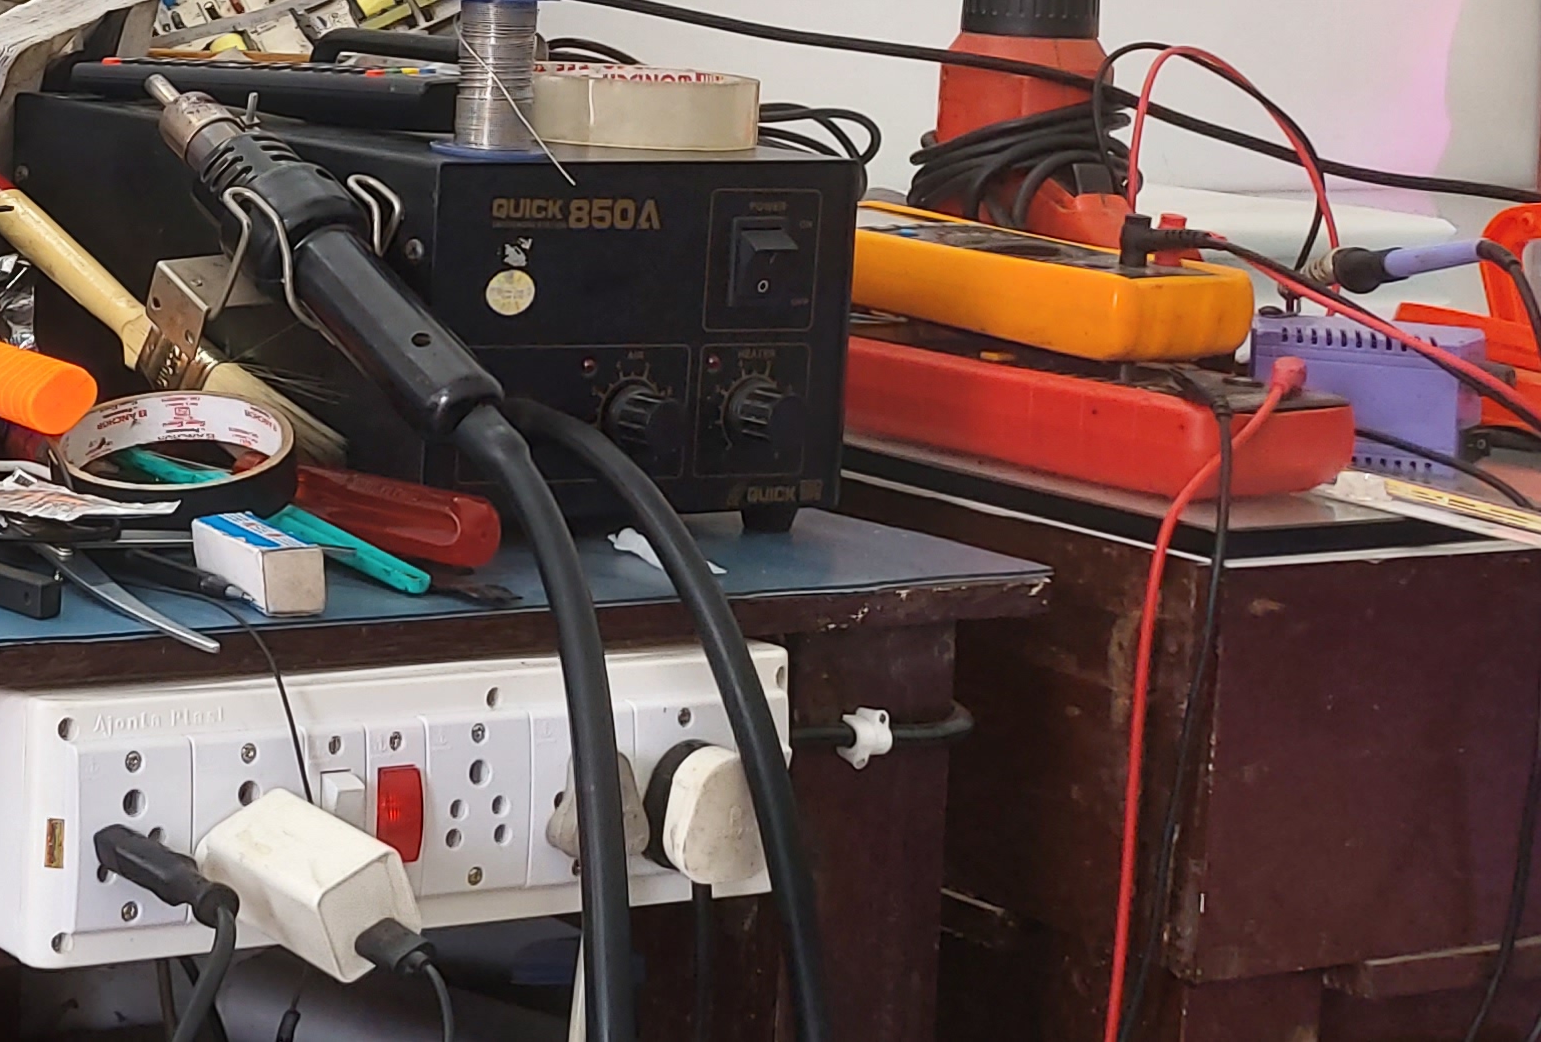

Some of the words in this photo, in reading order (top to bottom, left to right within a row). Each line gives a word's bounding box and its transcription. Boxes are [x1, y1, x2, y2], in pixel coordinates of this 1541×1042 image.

[492, 197, 564, 220] QUICK
[567, 197, 662, 231] 850A
[96, 411, 135, 430] ANCHOR
[747, 485, 796, 503] QUICK
[93, 712, 162, 738] Ajonta
[170, 705, 226, 728] Plast
